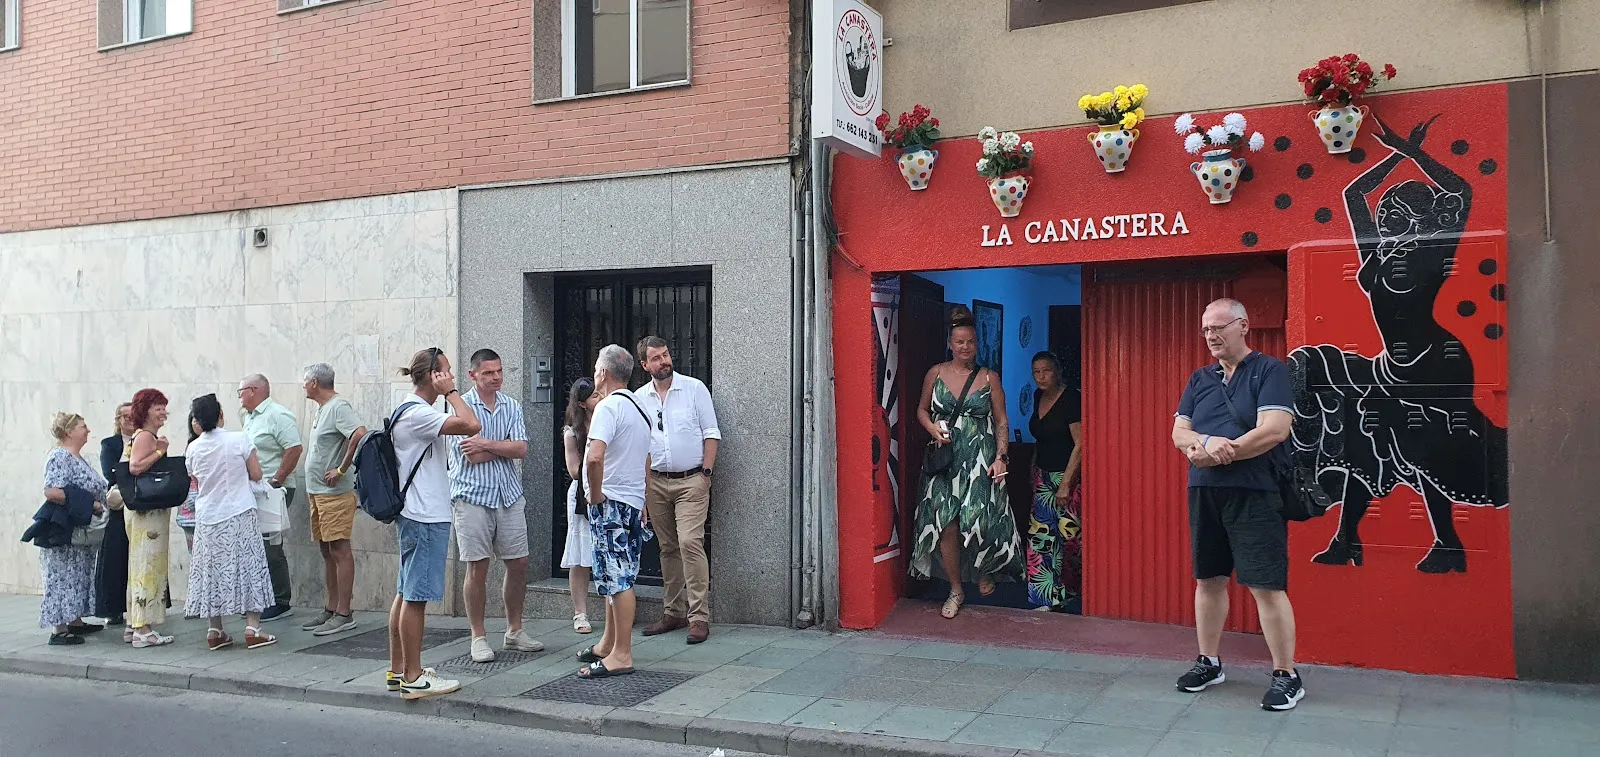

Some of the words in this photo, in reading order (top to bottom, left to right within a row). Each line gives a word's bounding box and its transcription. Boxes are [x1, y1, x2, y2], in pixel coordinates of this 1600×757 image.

[838, 26, 846, 42] LA
[845, 13, 877, 61] CANASTERA
[846, 121, 857, 136] 662
[858, 127, 868, 141] 143
[868, 132, 878, 145] 231
[980, 223, 1013, 247] LA
[1024, 211, 1190, 244] CANASTERA
